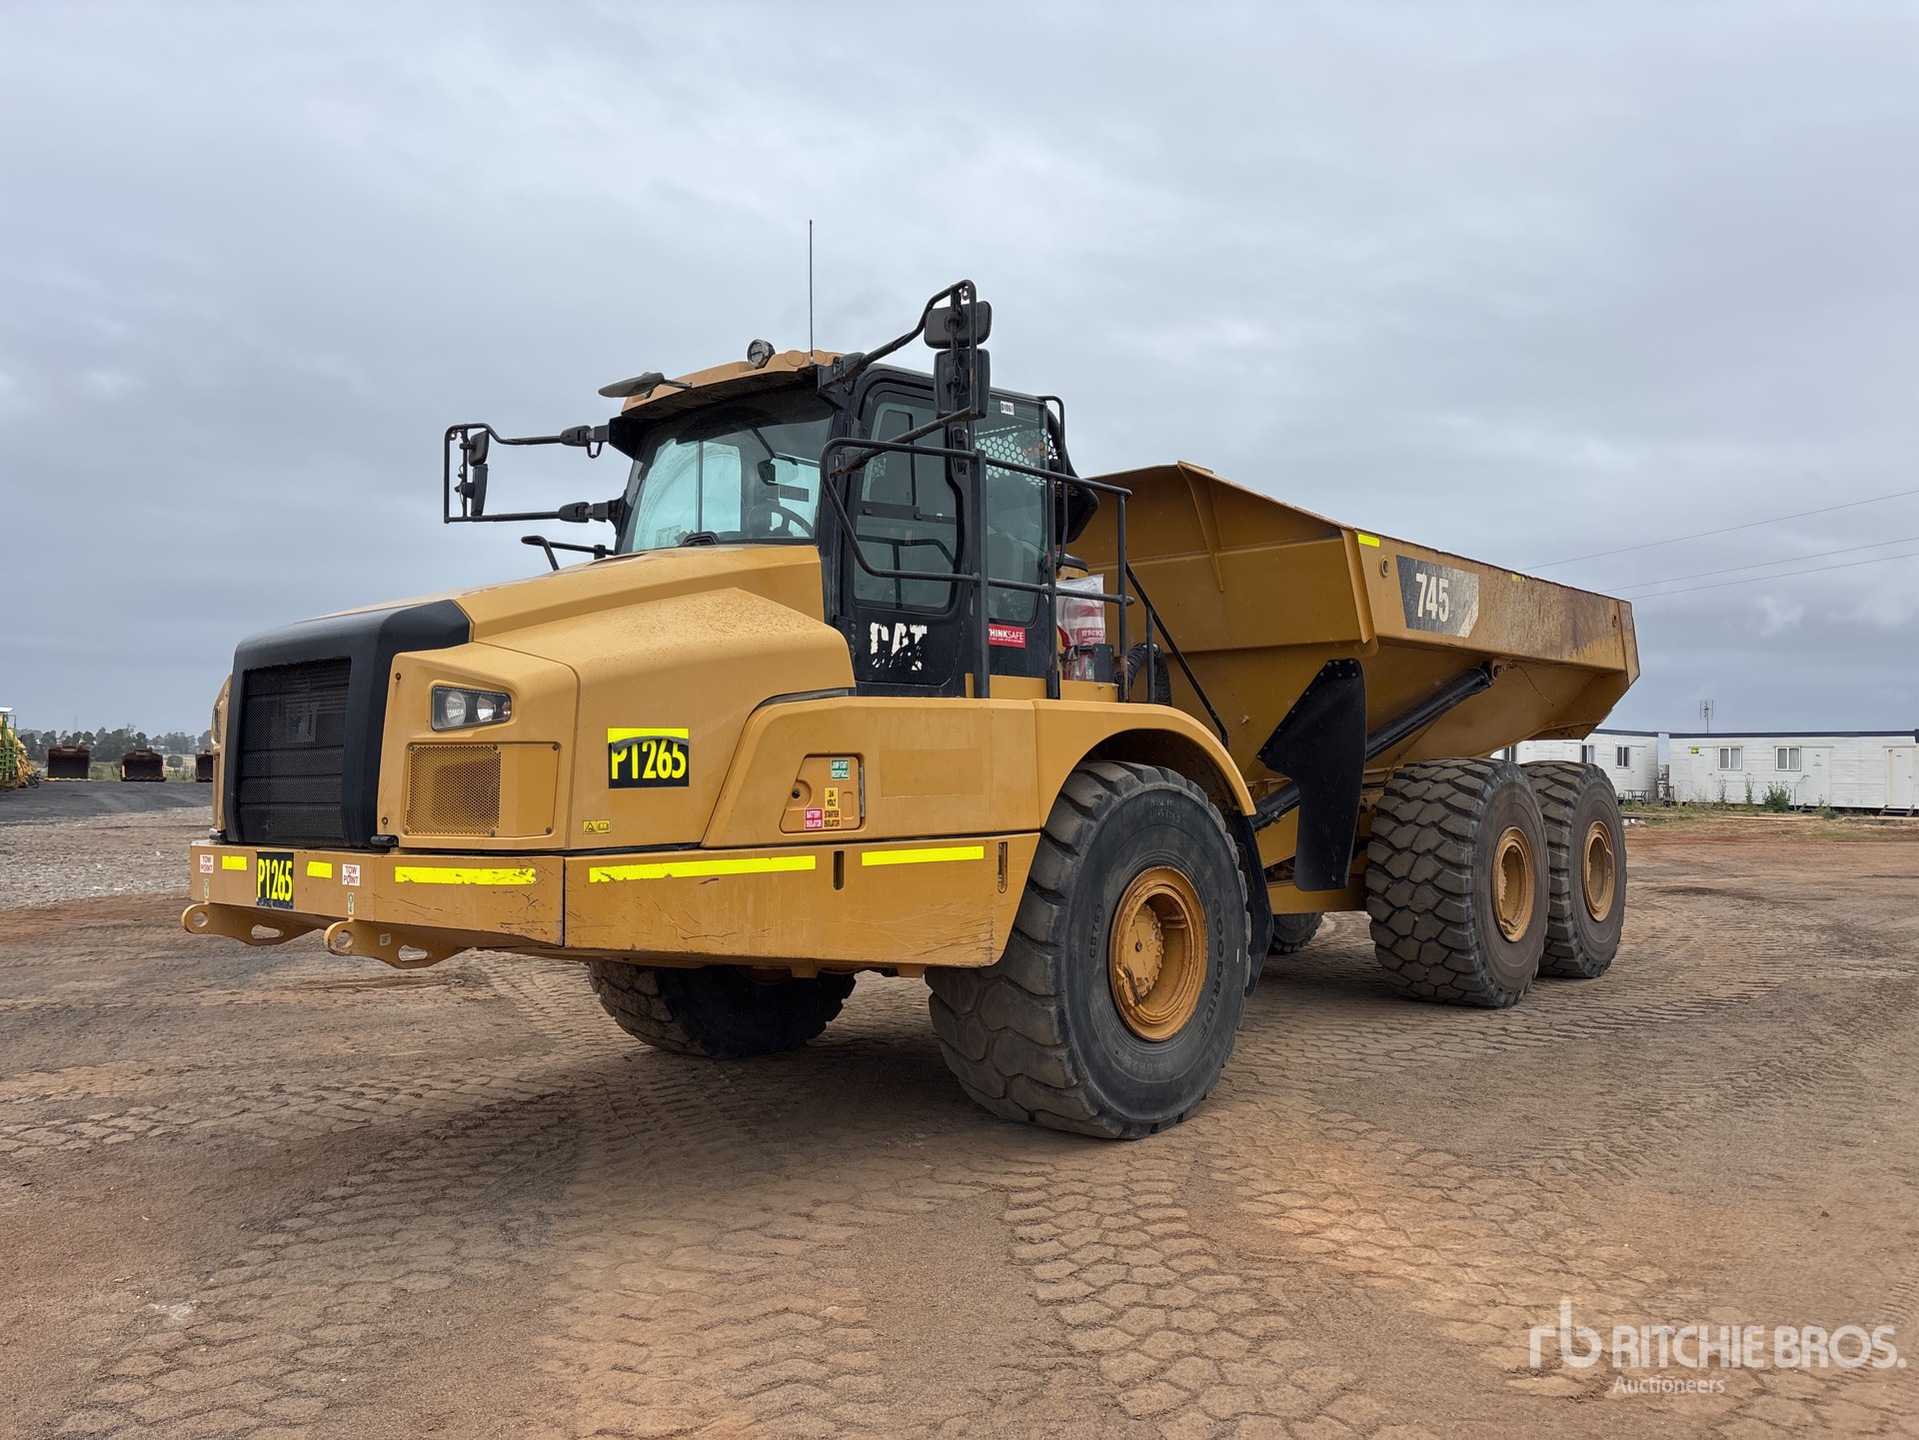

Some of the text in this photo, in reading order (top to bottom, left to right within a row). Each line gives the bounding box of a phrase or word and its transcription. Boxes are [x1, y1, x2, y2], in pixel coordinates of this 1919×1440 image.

[1415, 573, 1449, 623] 745
[611, 739, 687, 779] P1265
[200, 864, 213, 872] POINT
[202, 855, 212, 864] TOW
[344, 865, 358, 875] TOW
[257, 858, 293, 902] P1265
[343, 874, 359, 885] POINT
[1198, 898, 1225, 1040] GOODRIDE
